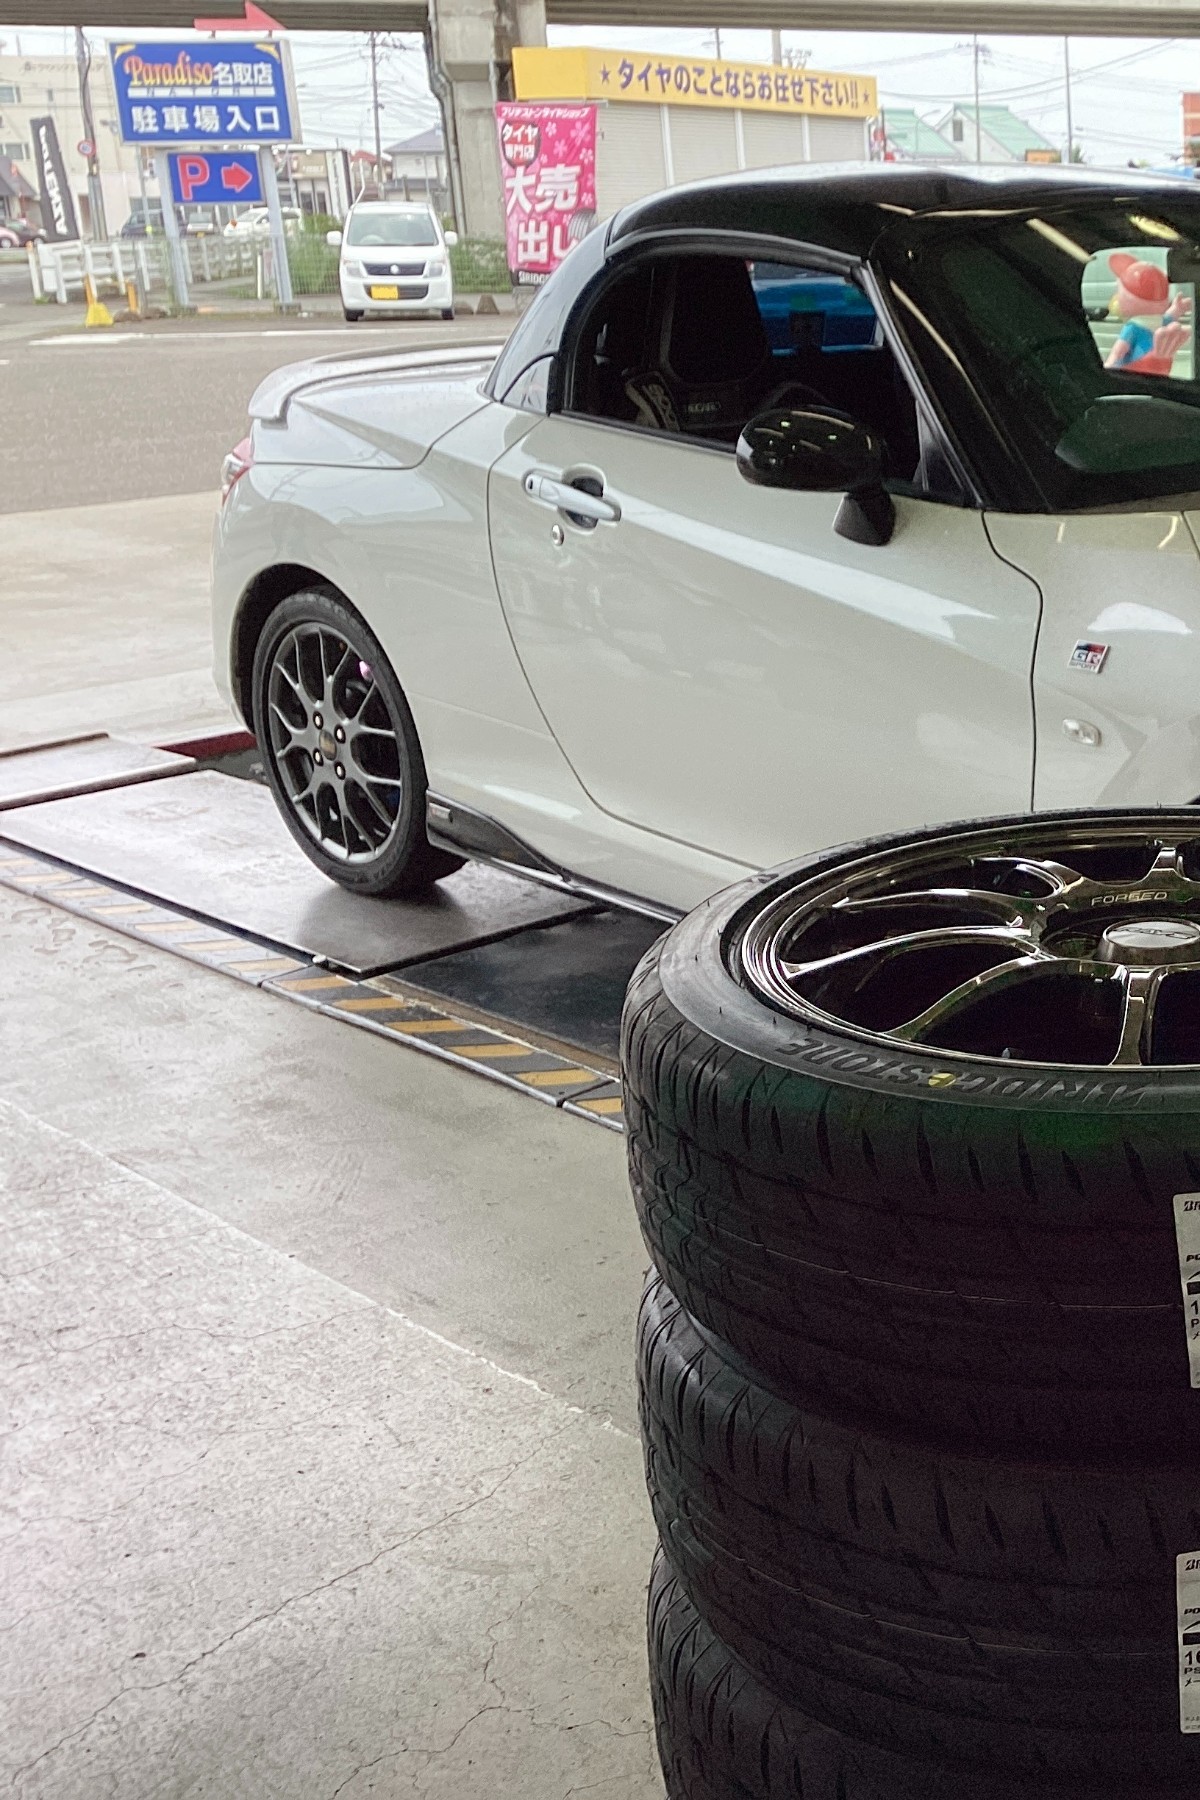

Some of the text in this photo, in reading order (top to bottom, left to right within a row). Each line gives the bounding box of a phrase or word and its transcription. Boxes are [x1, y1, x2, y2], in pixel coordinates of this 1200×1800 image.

[124, 50, 273, 86] Paradiso 名取店
[131, 105, 281, 133] 駐車場入口
[502, 123, 539, 142] タイヤ
[176, 154, 210, 201] P
[1091, 891, 1168, 906] FORGED
[775, 1038, 1148, 1107] BRIDGESTONE
